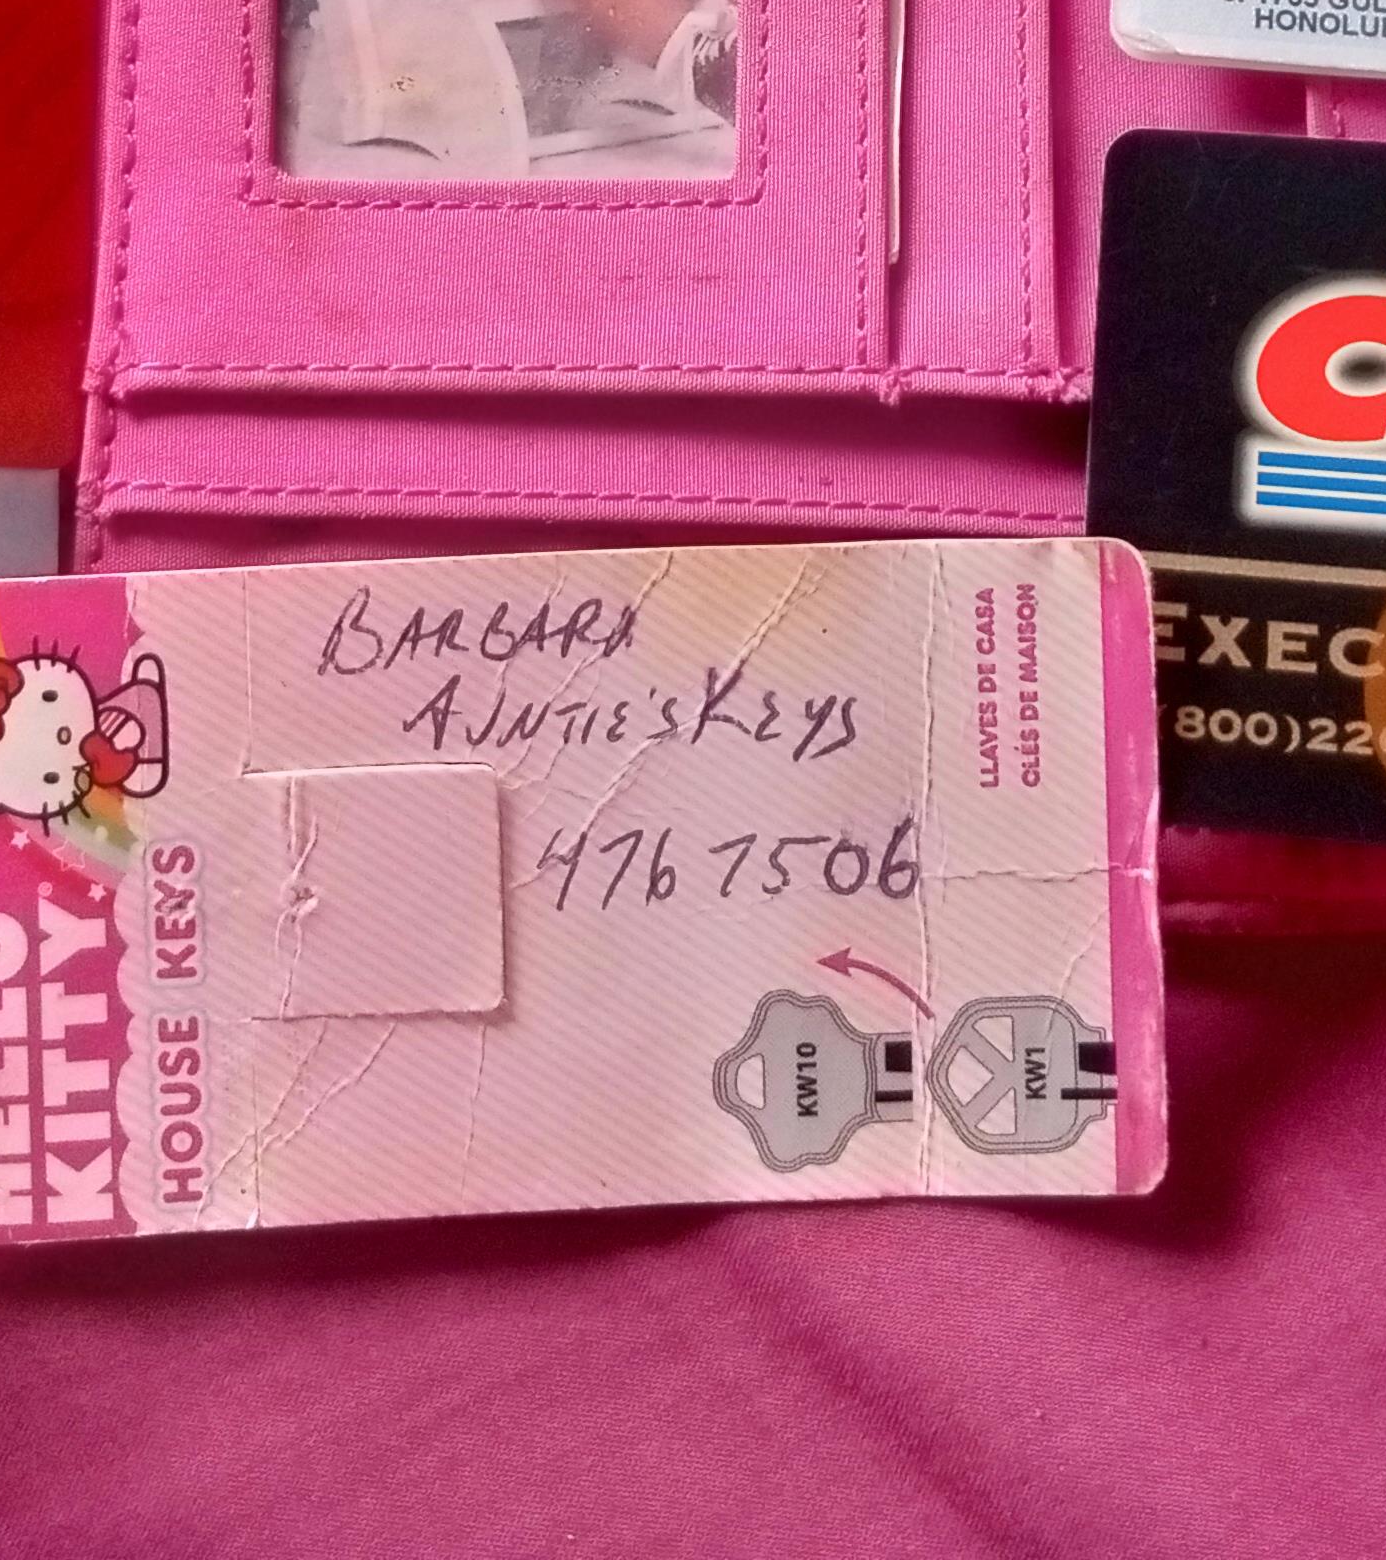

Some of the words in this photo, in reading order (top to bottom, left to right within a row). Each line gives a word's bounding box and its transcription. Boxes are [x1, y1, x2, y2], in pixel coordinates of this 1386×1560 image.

[317, 585, 637, 676] BARBARA
[975, 587, 995, 655] CASA
[1016, 583, 1038, 683] MAISON
[977, 663, 996, 693] DE
[1019, 690, 1039, 721] DE
[979, 701, 1000, 788] LLAVES
[537, 826, 675, 911] 476
[709, 813, 920, 900] 7506
[152, 844, 198, 980] KEYS
[38, 896, 113, 1223] KITTY
[796, 1042, 819, 1117] KW10
[1024, 1046, 1047, 1099] KW1
[157, 1015, 204, 1204] HOUSE
